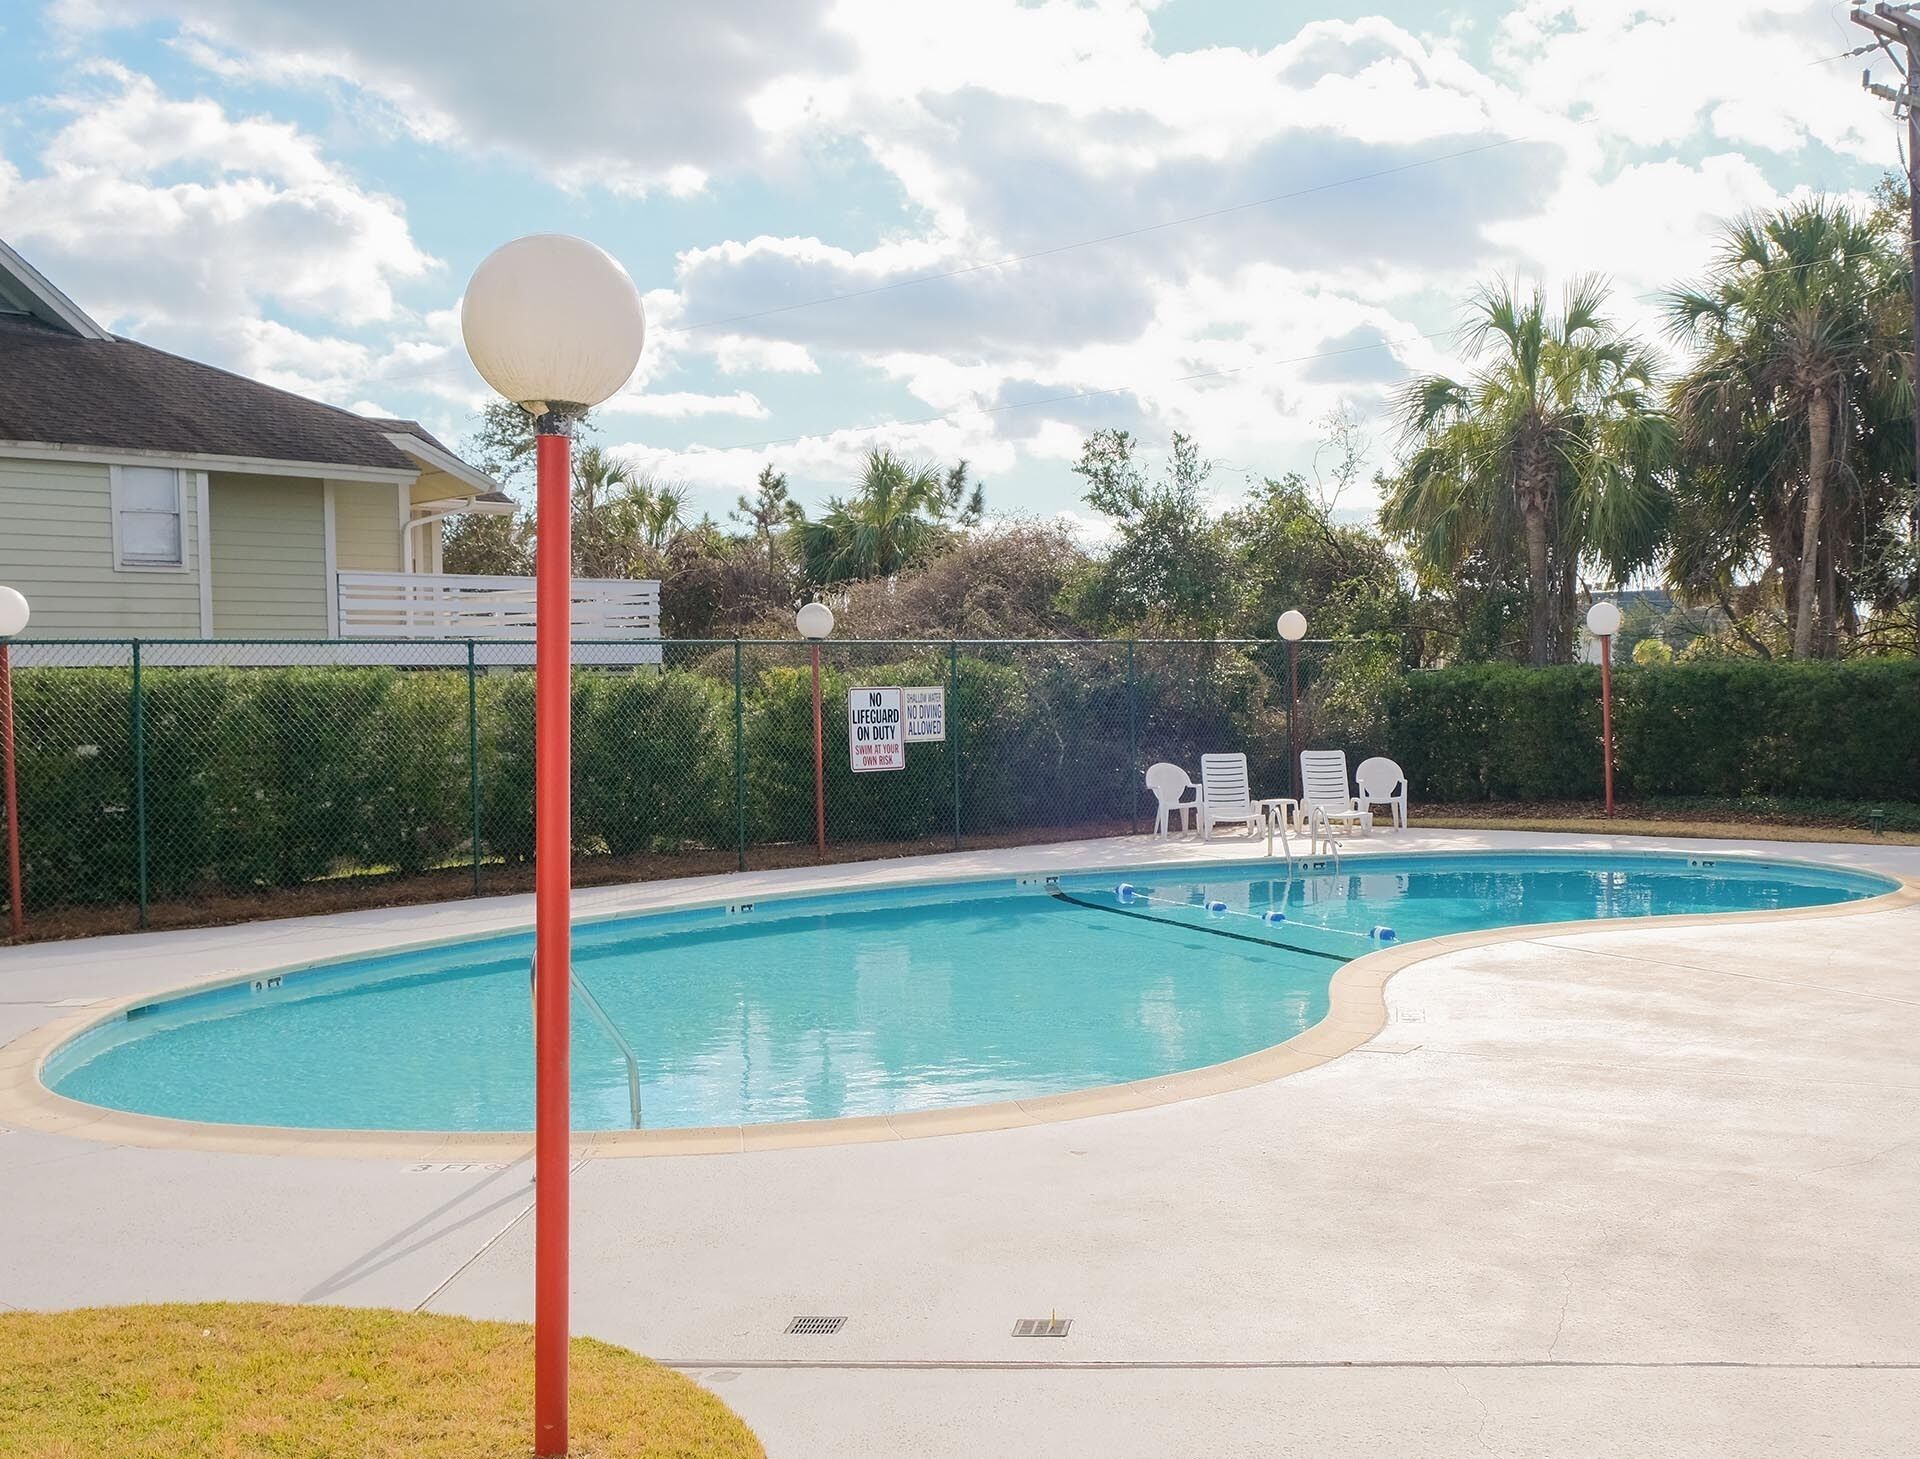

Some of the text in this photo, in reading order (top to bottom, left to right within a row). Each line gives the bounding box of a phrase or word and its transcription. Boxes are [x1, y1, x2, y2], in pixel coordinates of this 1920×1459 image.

[869, 692, 882, 707] NO
[906, 692, 941, 704] SHALLOW WATER
[852, 709, 900, 724] LIFEGUARD
[907, 703, 942, 720] NO DIVING
[857, 725, 896, 741] ON DUTY
[908, 720, 942, 735] ALLOWED
[855, 743, 900, 756] SWIM AT YOUR
[862, 754, 894, 766] OWN RISK
[410, 1164, 479, 1172] 3 FT
